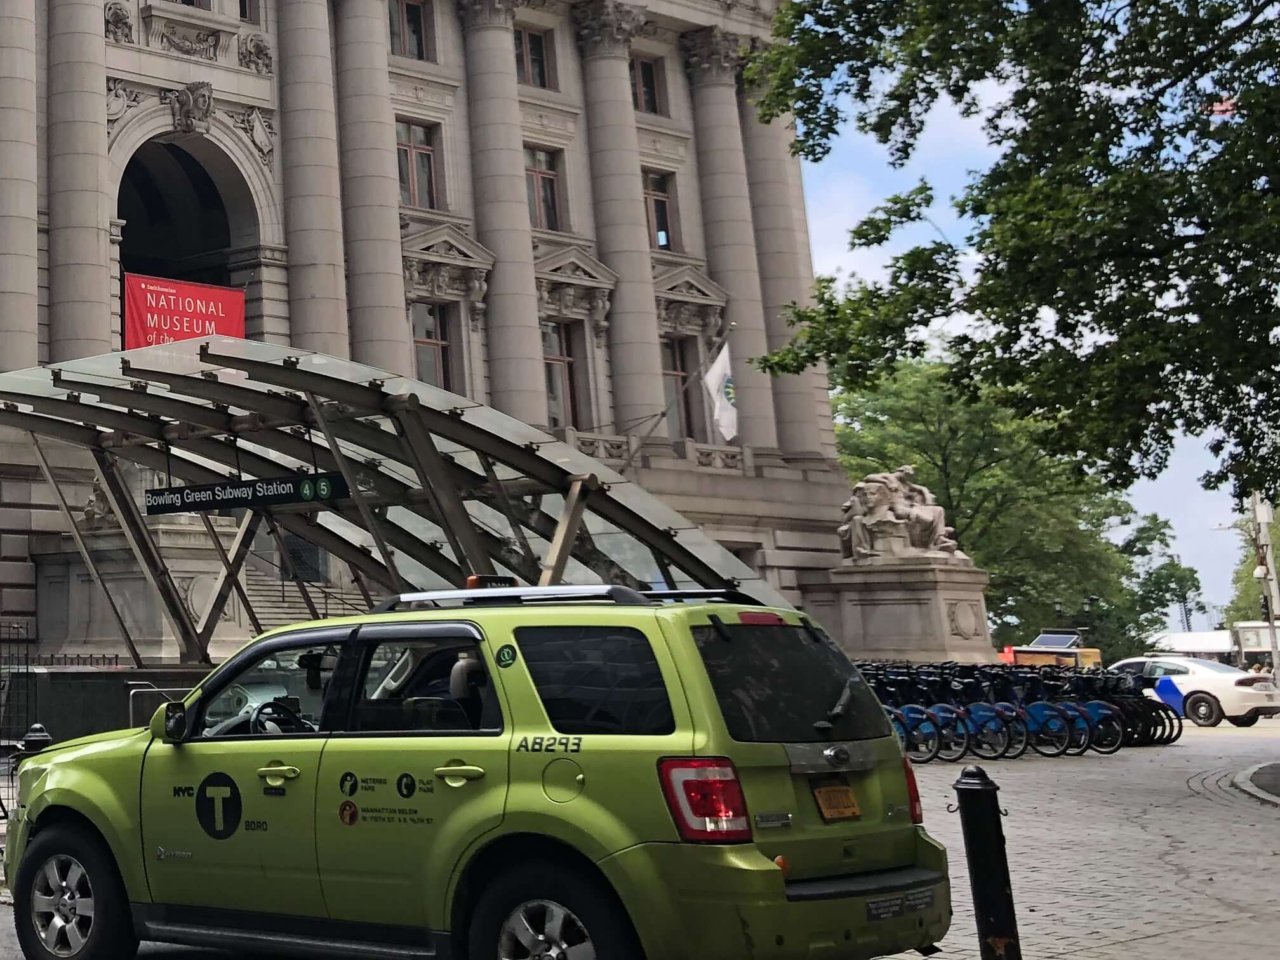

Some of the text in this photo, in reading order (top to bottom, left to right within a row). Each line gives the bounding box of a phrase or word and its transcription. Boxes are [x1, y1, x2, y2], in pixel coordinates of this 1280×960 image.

[146, 293, 226, 317] NATIONAL
[146, 313, 216, 335] MUSEUM
[147, 331, 174, 345] of the
[145, 481, 328, 507] Bowling Green Subway Station 4 5
[173, 786, 195, 797] NYC
[205, 786, 231, 831] T
[244, 821, 268, 832] BORO
